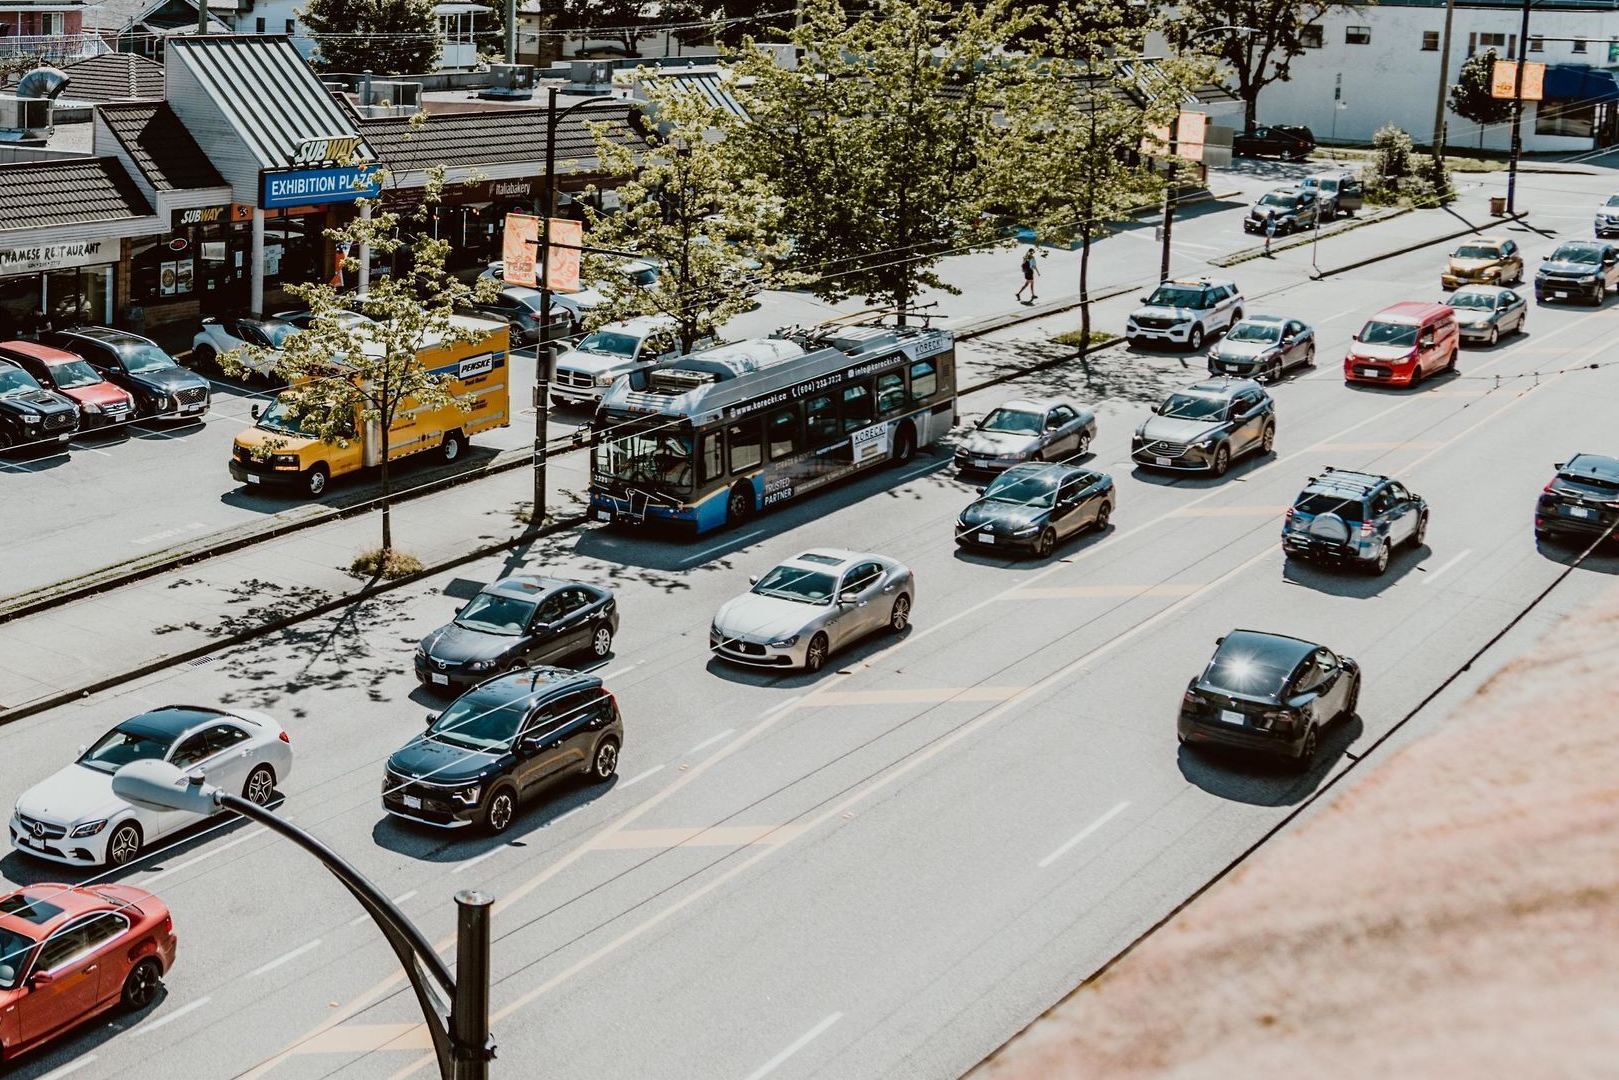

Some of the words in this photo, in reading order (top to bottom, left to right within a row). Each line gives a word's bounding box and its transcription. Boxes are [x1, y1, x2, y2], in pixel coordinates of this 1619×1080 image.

[294, 137, 363, 164] SUBWAY
[271, 176, 336, 196] EXHIBITION
[339, 172, 375, 190] PLAZA
[181, 207, 224, 224] SUBWAY
[461, 359, 492, 373] PENSKE
[764, 488, 792, 506] PARTNER
